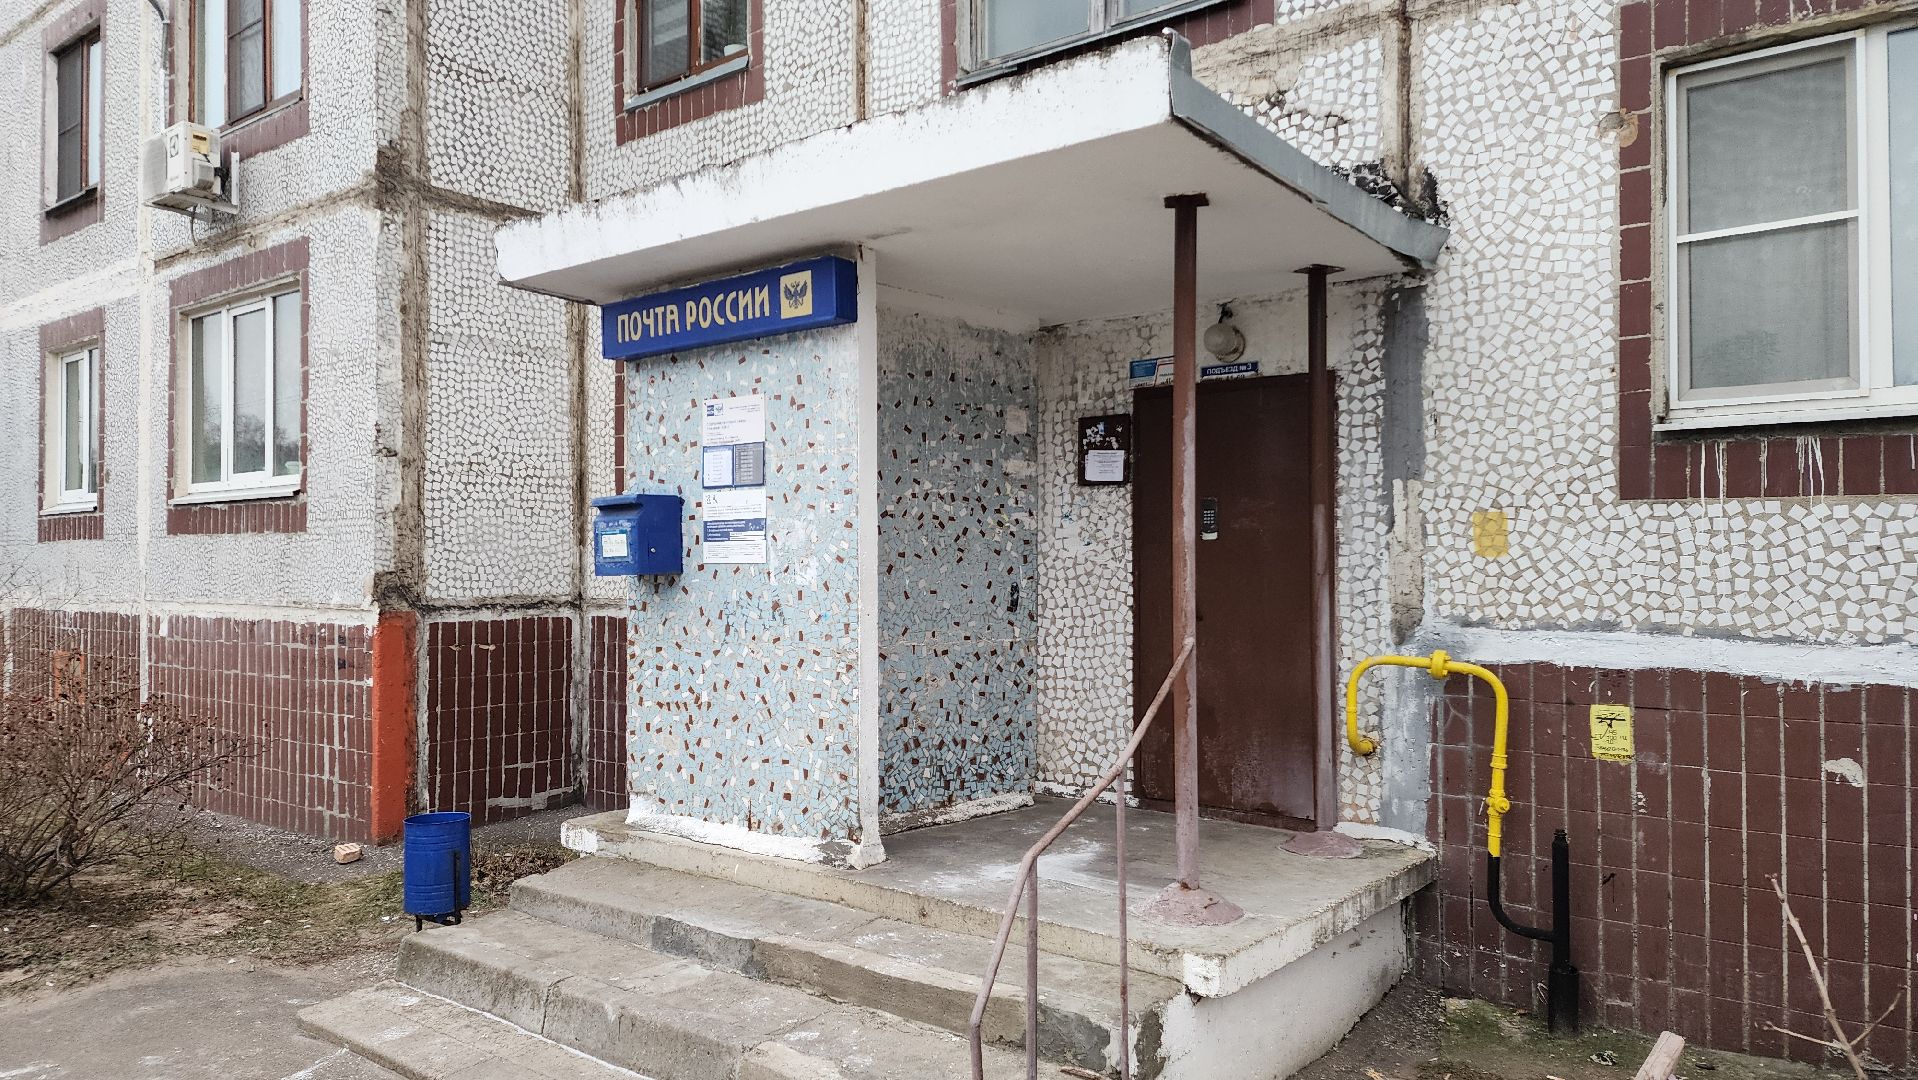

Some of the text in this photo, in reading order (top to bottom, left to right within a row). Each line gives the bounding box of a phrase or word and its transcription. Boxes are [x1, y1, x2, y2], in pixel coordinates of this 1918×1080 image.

[617, 283, 770, 343] ПОЧТА РОССИИ
[1206, 365, 1239, 375] ПОДЪЕЗД
